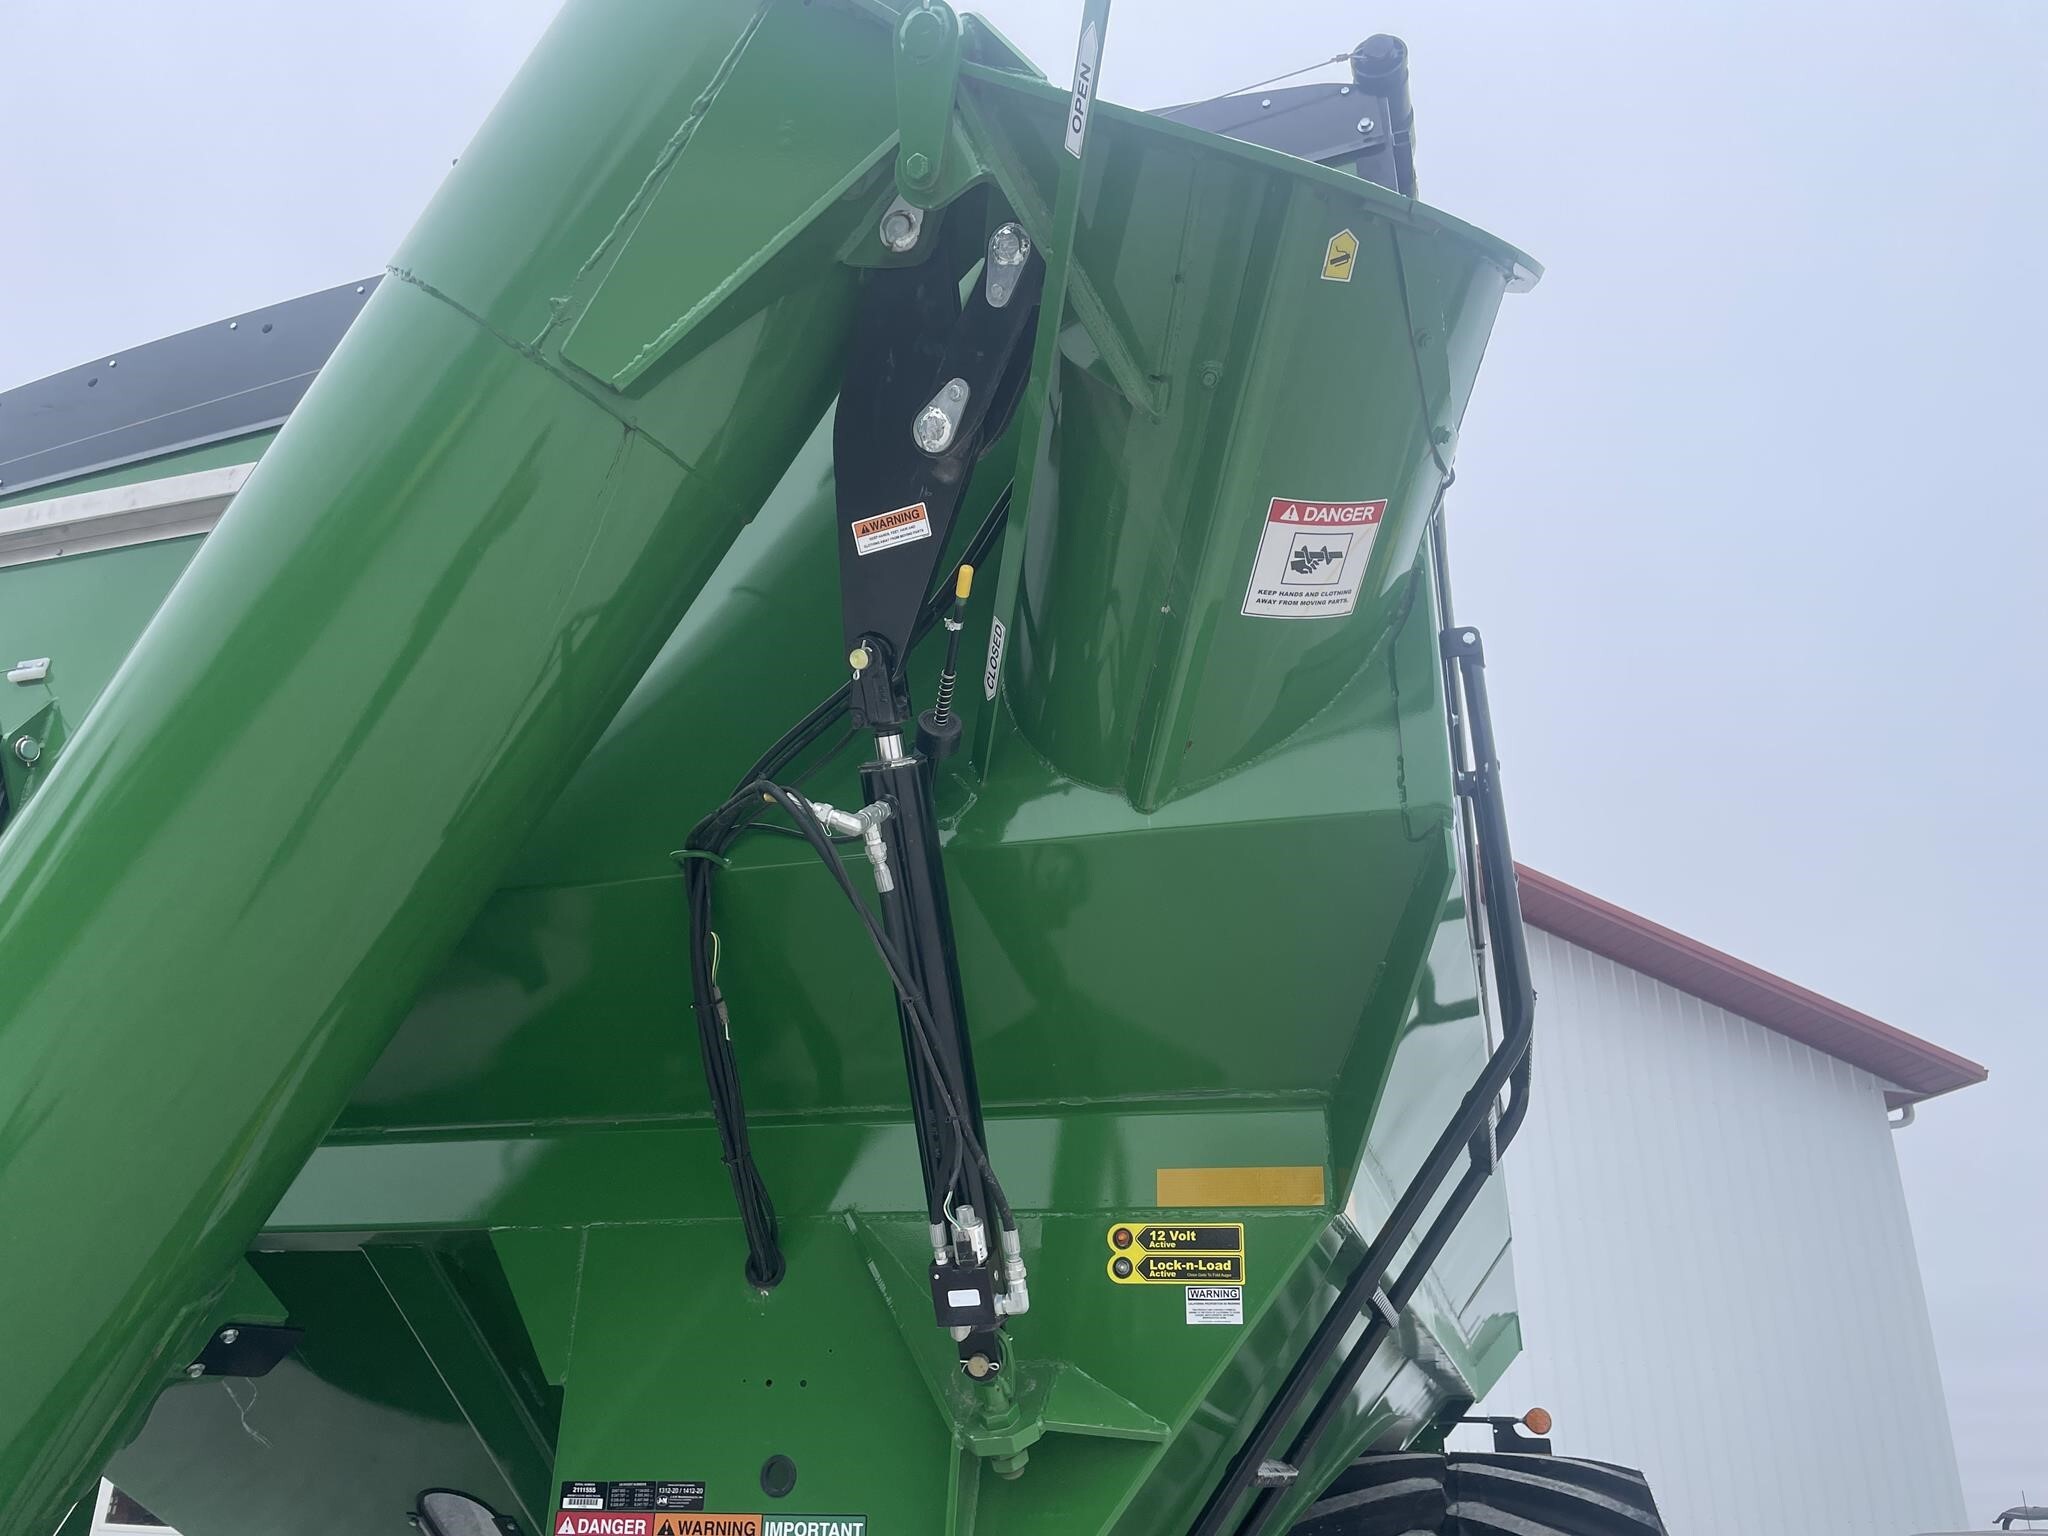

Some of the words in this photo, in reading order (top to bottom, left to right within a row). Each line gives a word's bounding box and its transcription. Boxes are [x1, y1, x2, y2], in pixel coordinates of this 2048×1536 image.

[1072, 62, 1091, 133] OPEN
[869, 509, 920, 531] WARNING
[1303, 506, 1375, 522] DANGER
[1320, 589, 1352, 597] CLOTHING
[986, 624, 1003, 690] CLOSED
[1149, 1230, 1166, 1241] 12
[1169, 1230, 1197, 1241] Volt
[1149, 1259, 1232, 1271] Lock-n-Load
[1149, 1270, 1177, 1278] Active
[1190, 1289, 1238, 1298] WARNING
[577, 1518, 647, 1535] DANGER
[678, 1520, 756, 1536] WARNING
[765, 1521, 864, 1536] IMPORTANT
